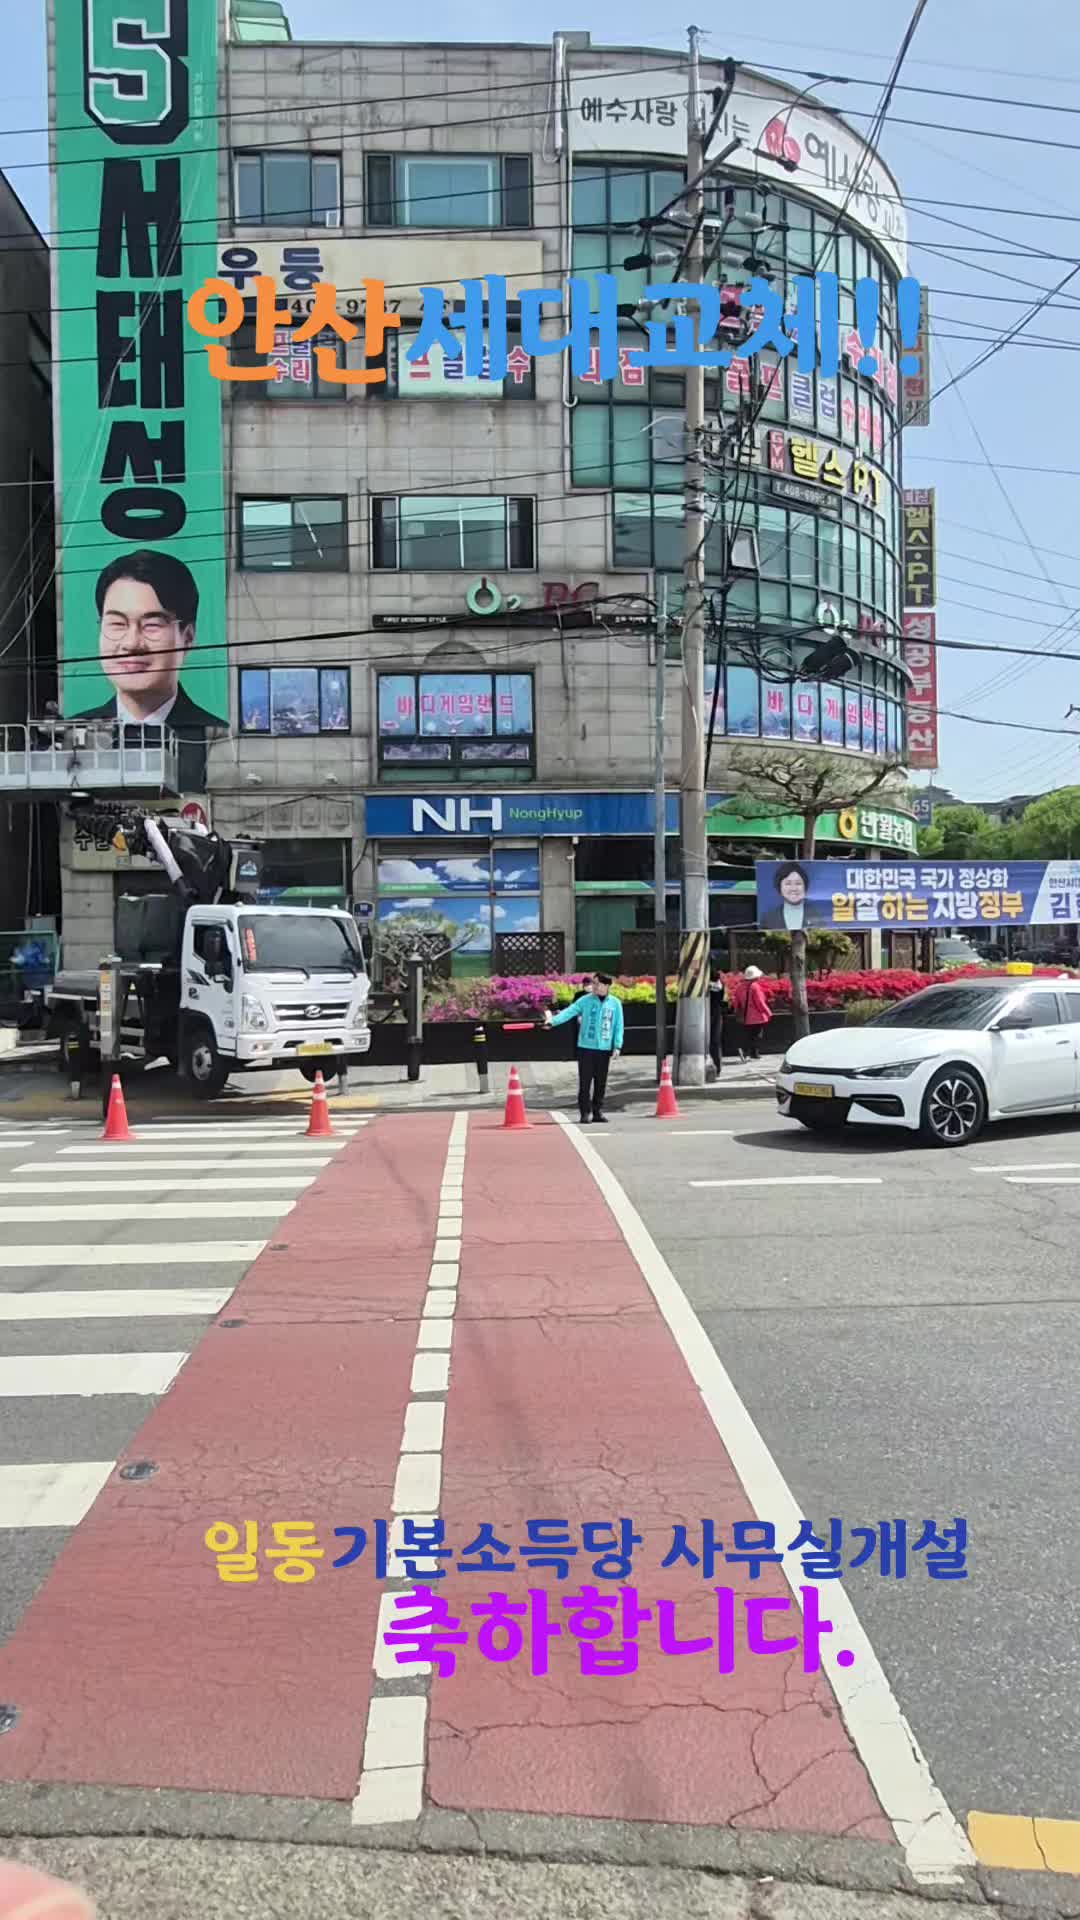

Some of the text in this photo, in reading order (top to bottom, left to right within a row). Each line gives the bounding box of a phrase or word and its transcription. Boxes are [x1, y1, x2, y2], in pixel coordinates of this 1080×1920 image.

[581, 98, 677, 127] 예수사랑
[97, 158, 187, 541] 서태성
[769, 431, 785, 472] GYM
[904, 615, 935, 751] 성공부동산
[413, 798, 583, 832] NH NongHyup
[846, 867, 1009, 890] 대한민국 국가 정상화
[832, 890, 1024, 922] 일잘하는 지방정부
